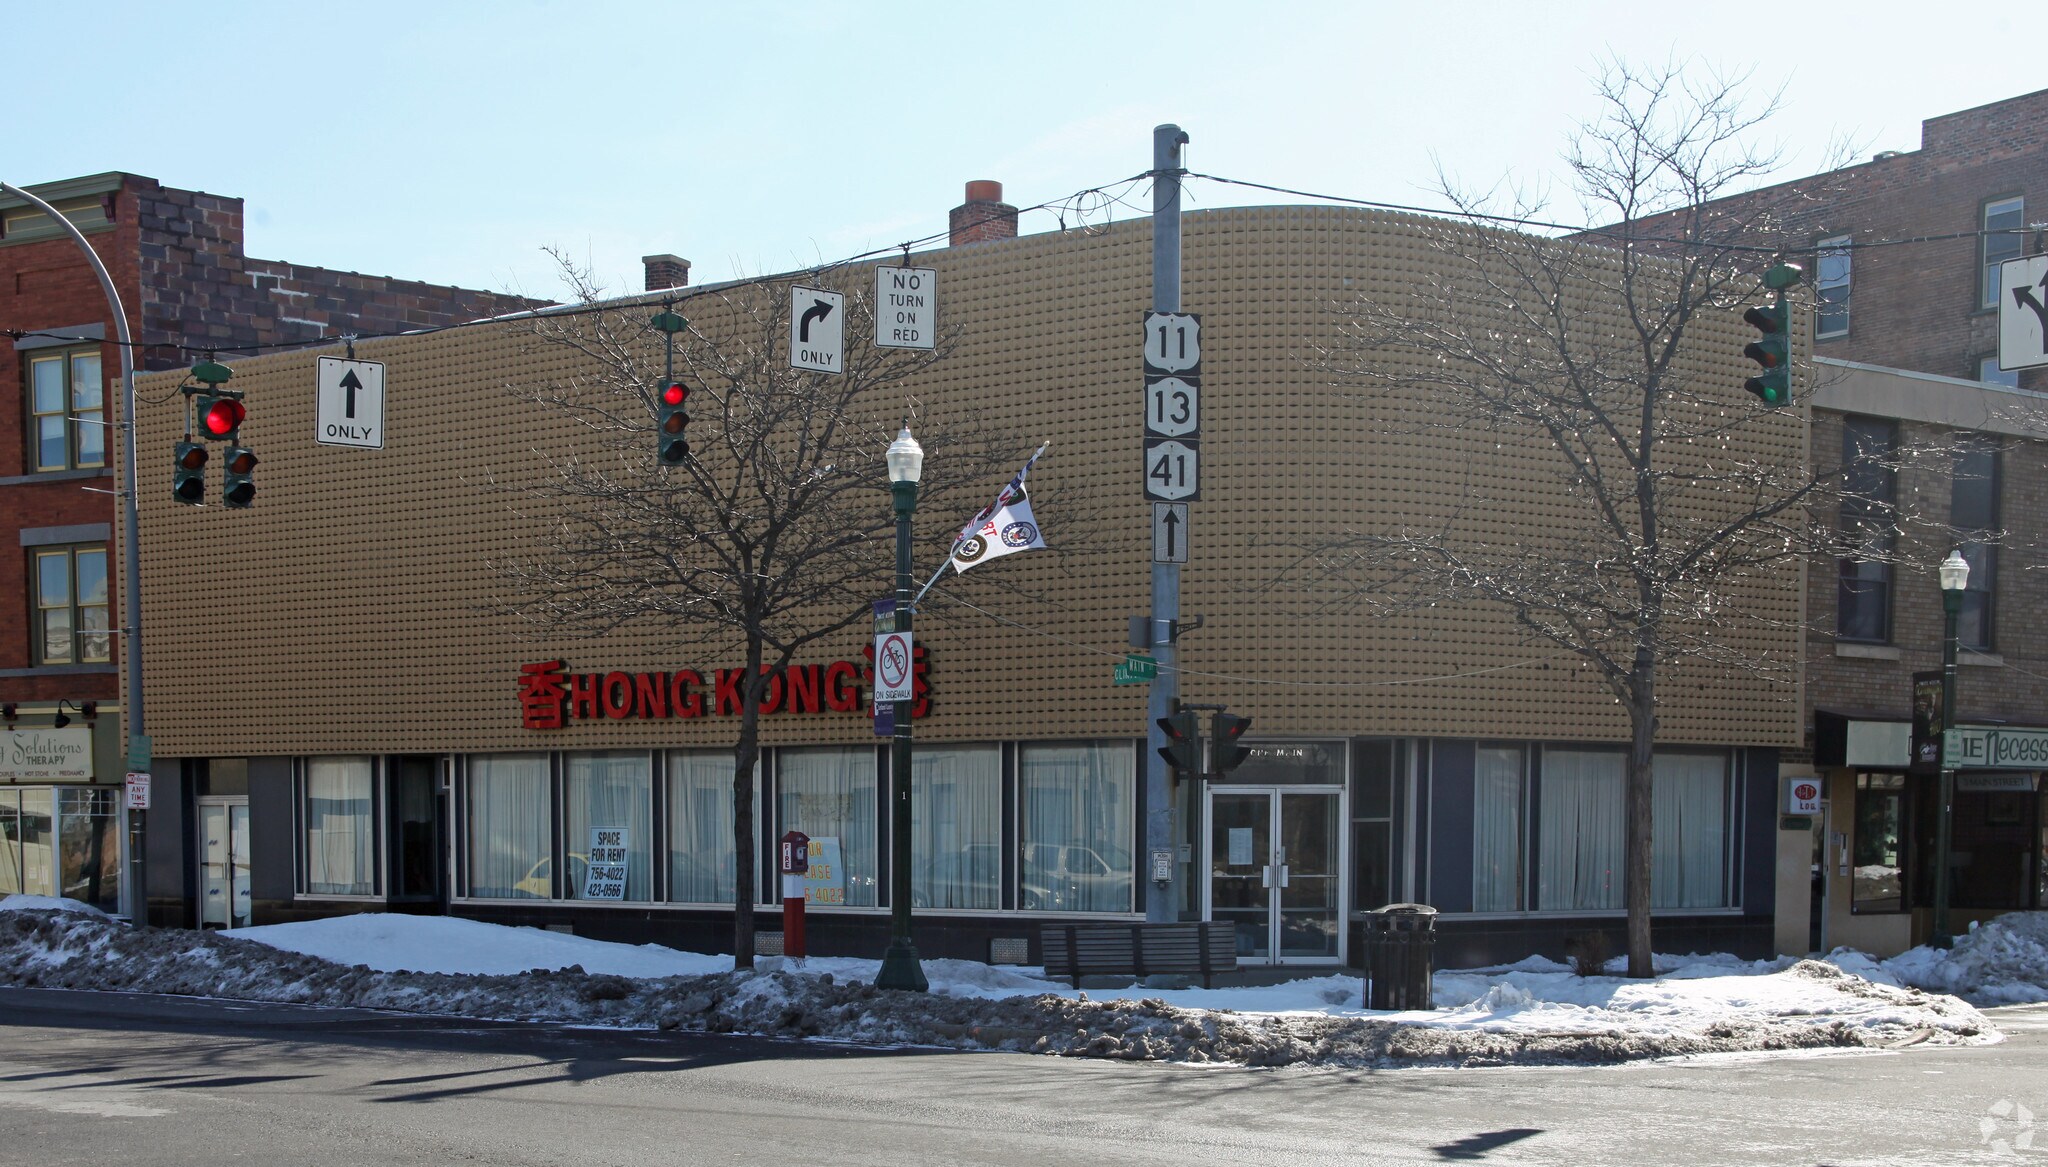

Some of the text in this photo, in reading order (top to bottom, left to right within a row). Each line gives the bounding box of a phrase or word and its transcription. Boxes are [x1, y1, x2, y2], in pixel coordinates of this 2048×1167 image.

[893, 273, 921, 290] NO
[889, 293, 924, 308] TURN
[896, 311, 916, 325] ON
[893, 328, 919, 342] RED
[1158, 325, 1185, 359] 11
[800, 349, 834, 366] ONLY
[1155, 390, 1190, 424] 13
[326, 423, 372, 440] ONLY
[1150, 454, 1185, 487] 41
[1129, 659, 1145, 673] MAIN
[516, 660, 566, 729] 香
[571, 668, 702, 720] HONG
[715, 660, 858, 717] KONG
[875, 689, 912, 700] ON SIDEWALK
[12, 733, 84, 766] Solutions
[26, 755, 66, 766] THERAPY
[130, 793, 145, 801] TIME
[597, 831, 621, 846] SPACE
[591, 848, 626, 862] FOR RENT
[808, 842, 823, 857] OR
[590, 866, 625, 881] 756-4022
[587, 883, 622, 897] 423-0566
